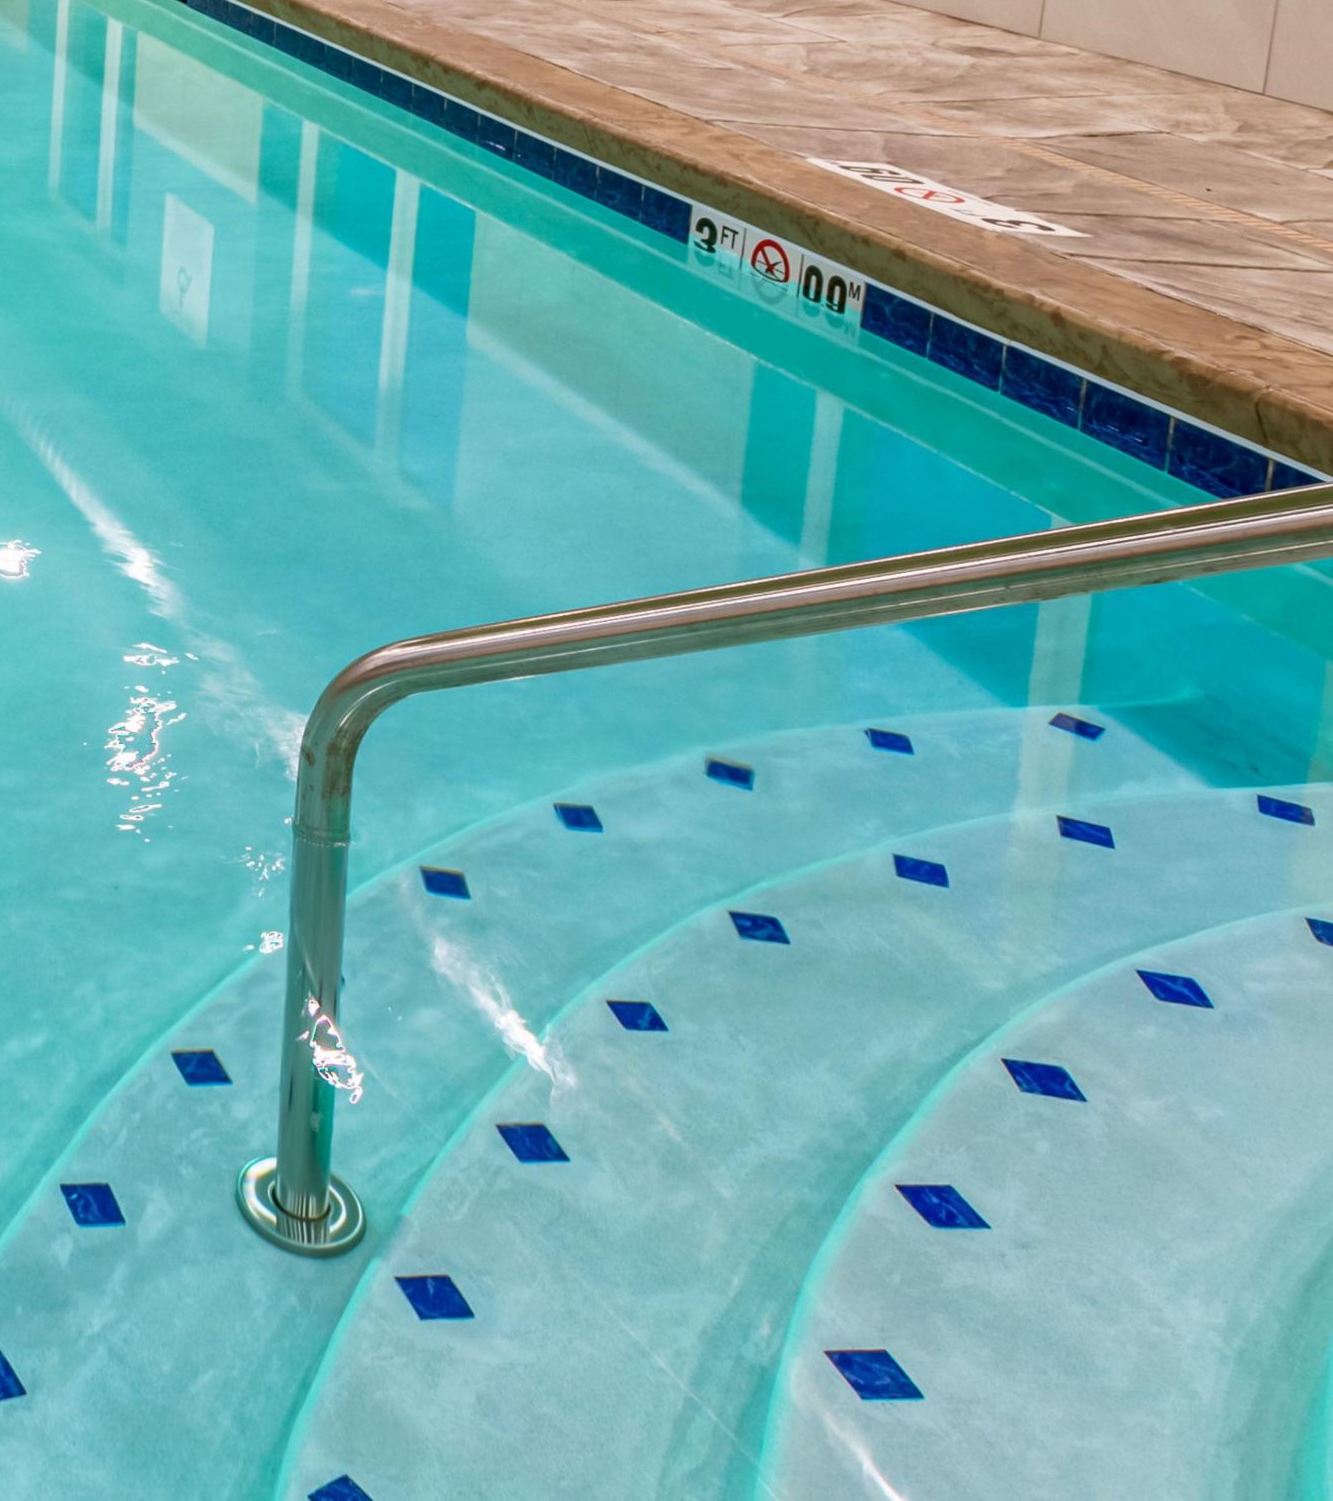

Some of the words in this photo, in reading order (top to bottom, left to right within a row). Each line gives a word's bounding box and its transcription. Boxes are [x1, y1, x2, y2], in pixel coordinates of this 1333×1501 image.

[693, 217, 718, 253] 3
[720, 225, 739, 249] FT
[849, 281, 861, 301] M
